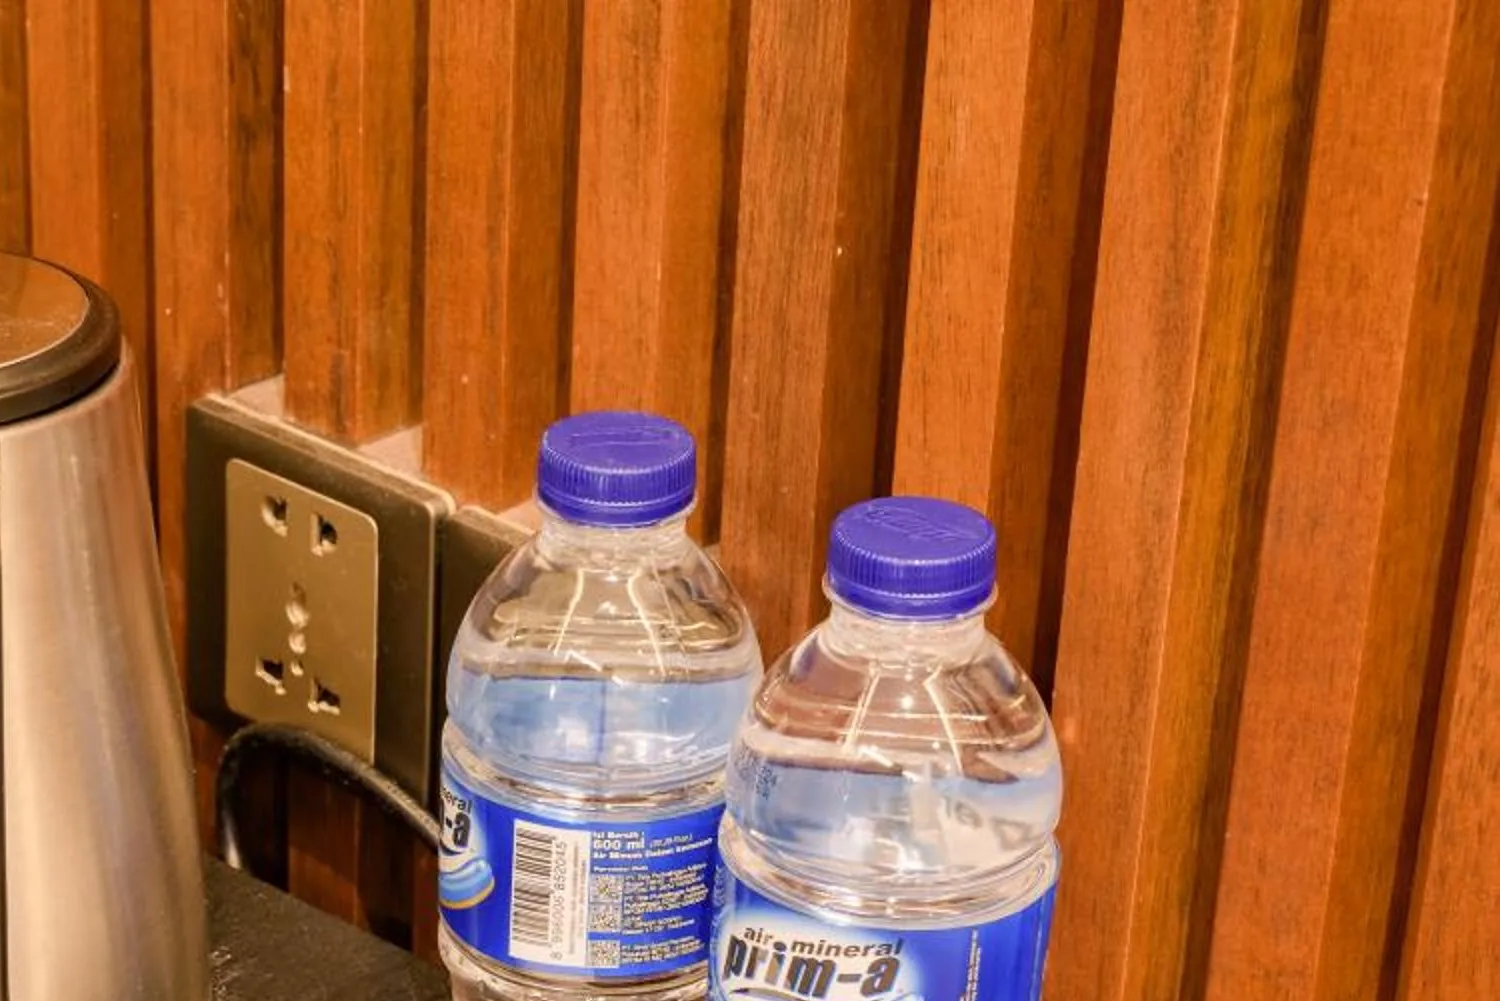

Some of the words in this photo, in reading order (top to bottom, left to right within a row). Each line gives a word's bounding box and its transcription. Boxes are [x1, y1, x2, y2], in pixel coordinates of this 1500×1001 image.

[722, 935, 901, 999] prim-a
[743, 927, 774, 945] air
[791, 937, 904, 959] mineral
